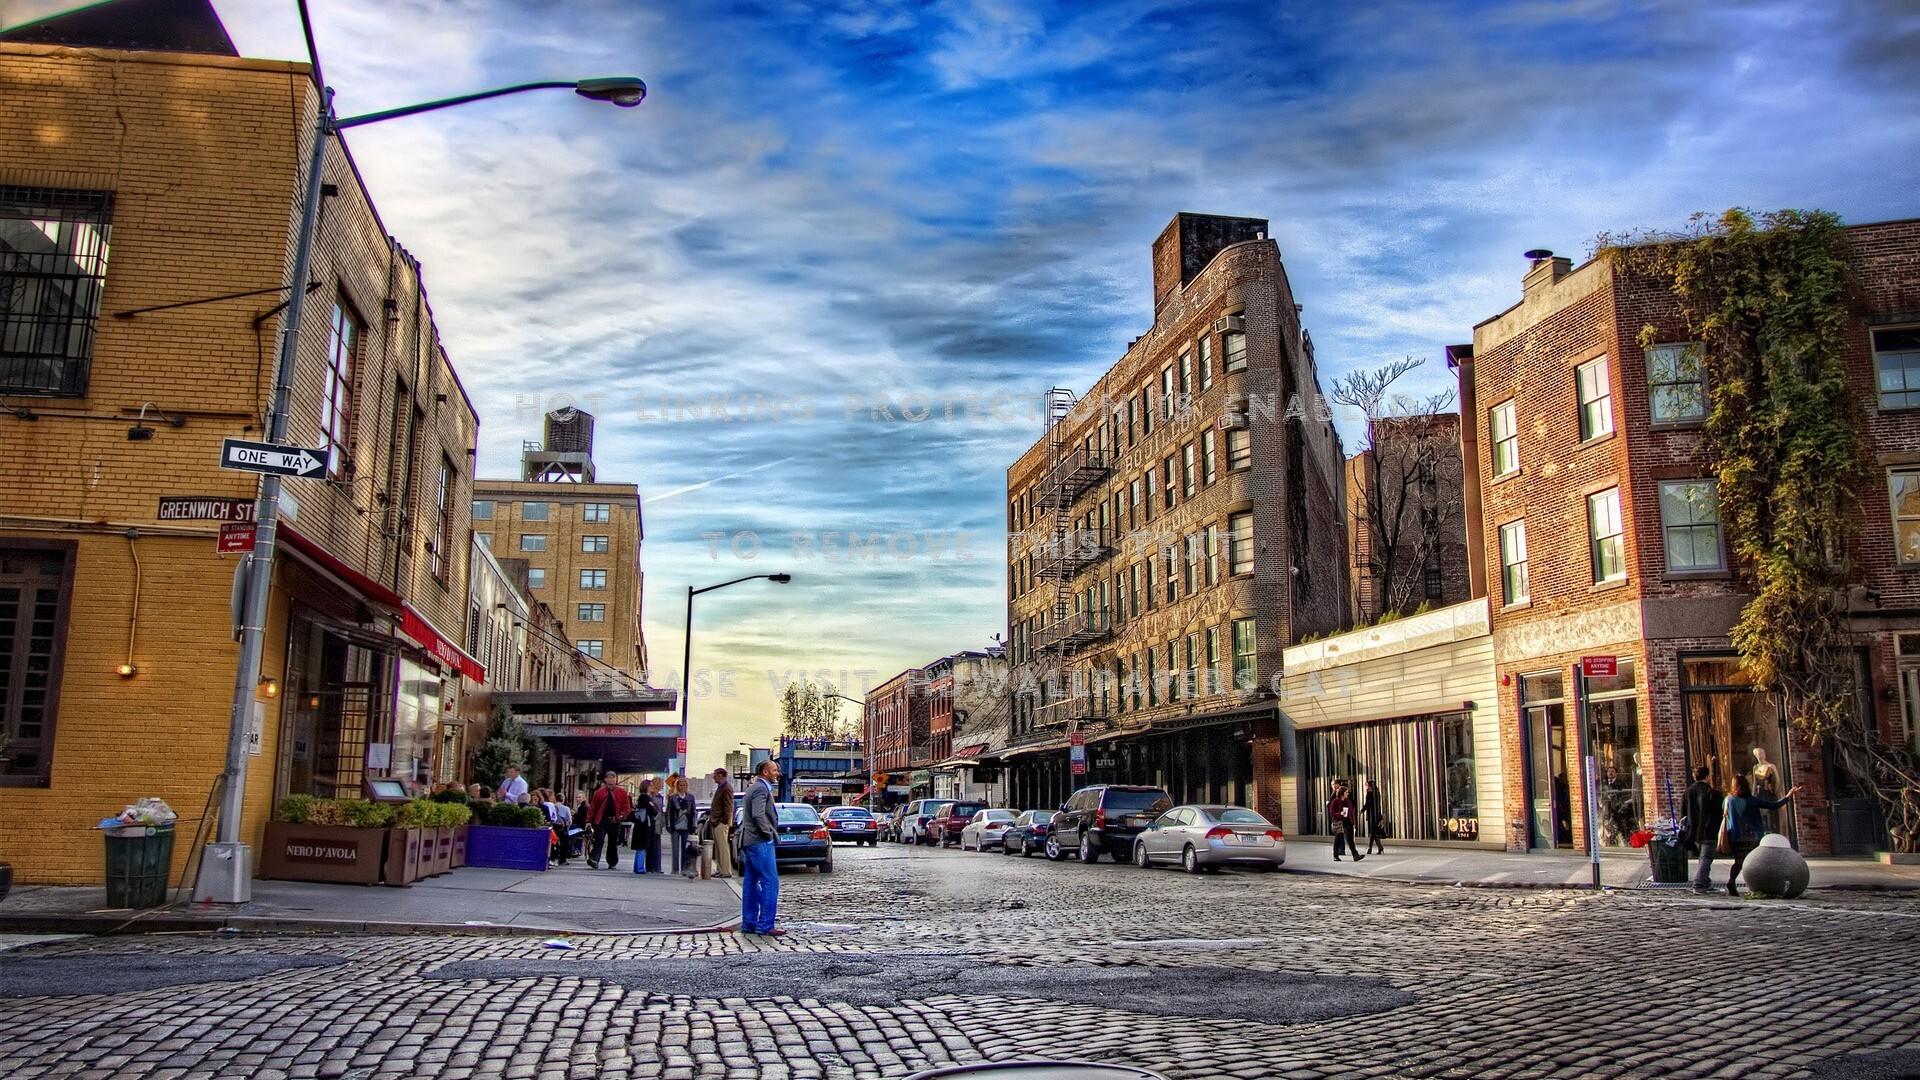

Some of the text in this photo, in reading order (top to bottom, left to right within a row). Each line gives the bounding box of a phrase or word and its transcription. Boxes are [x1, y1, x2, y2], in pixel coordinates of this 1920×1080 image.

[238, 450, 313, 470] ONE WAY
[160, 501, 254, 521] GREENWICH ST
[286, 845, 357, 860] NERO D'AVOLA
